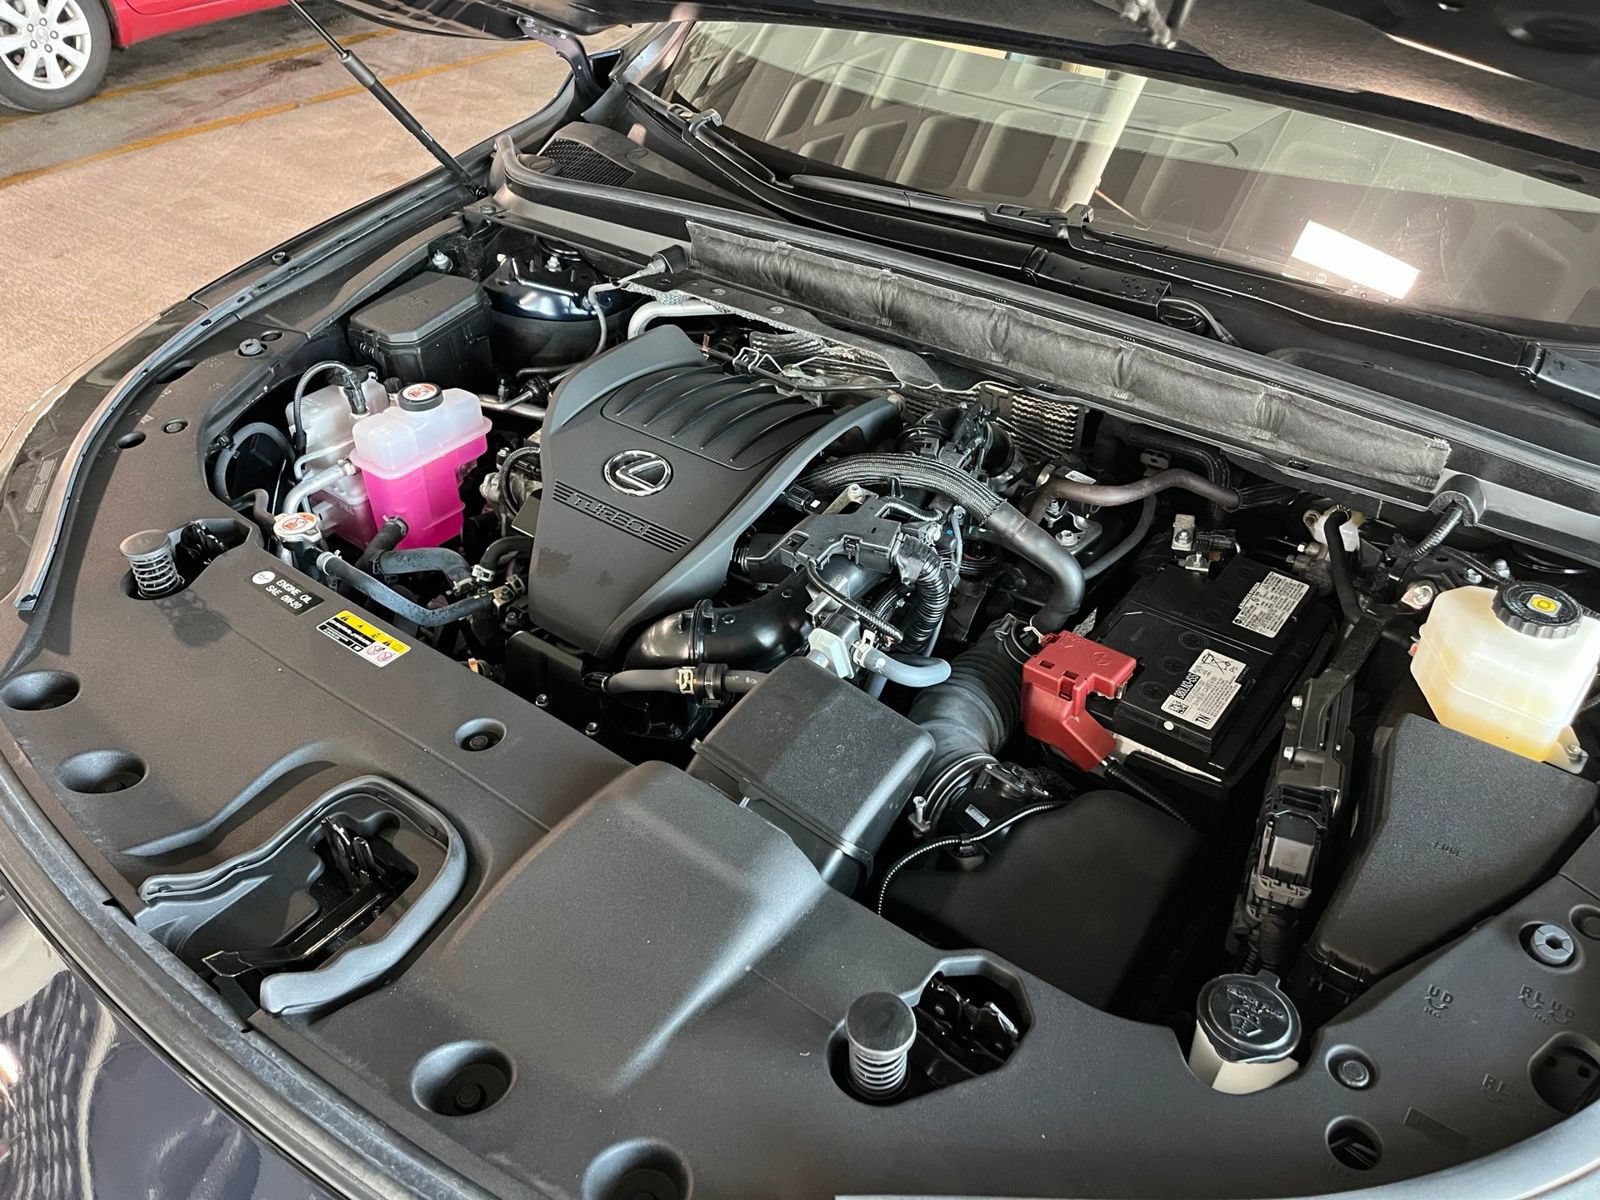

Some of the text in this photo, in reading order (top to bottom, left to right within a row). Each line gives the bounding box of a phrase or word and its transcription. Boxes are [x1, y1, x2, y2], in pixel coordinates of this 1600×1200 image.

[572, 492, 646, 534] TURBO
[265, 585, 283, 597] SAE
[276, 579, 314, 605] ENGINE OIL
